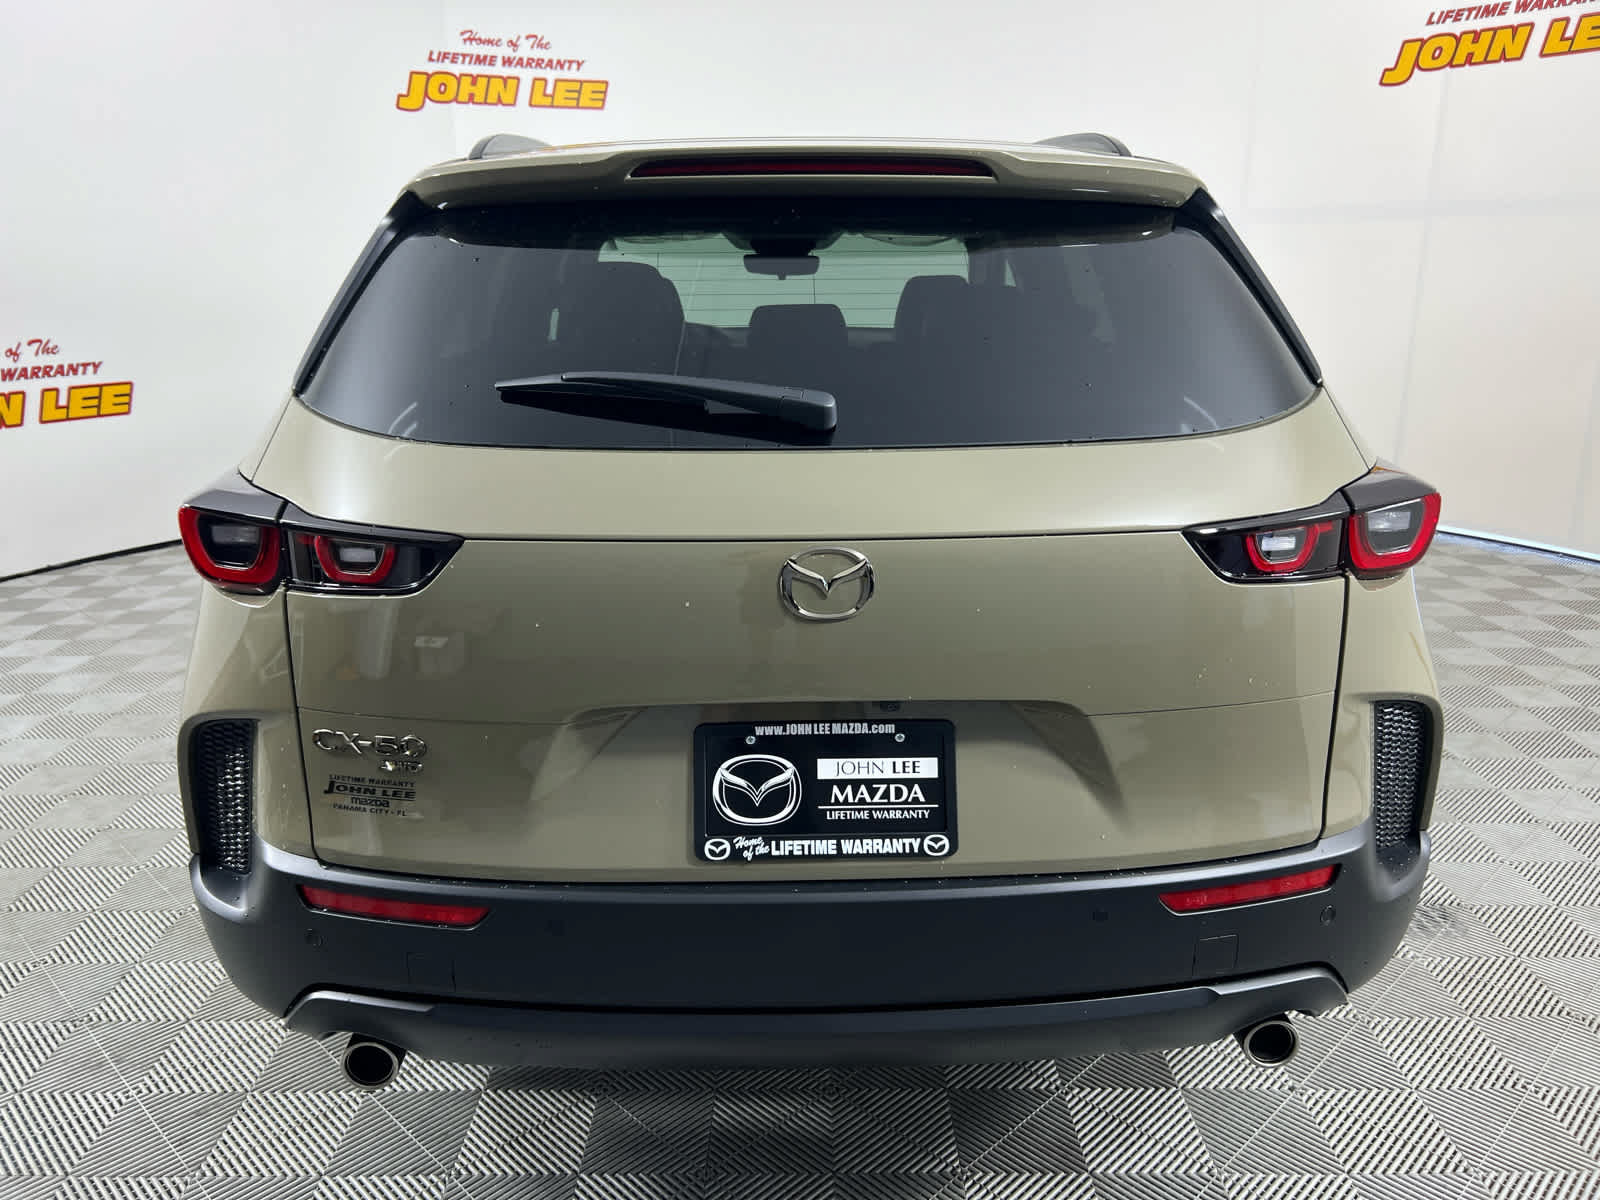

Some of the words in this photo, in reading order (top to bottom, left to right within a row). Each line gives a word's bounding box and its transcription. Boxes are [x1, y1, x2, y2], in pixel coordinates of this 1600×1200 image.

[1425, 2, 1512, 26] LIFETIME
[459, 30, 502, 47] Home
[506, 35, 520, 52] of
[525, 34, 551, 50] The
[427, 50, 498, 67] LIFETIME
[501, 55, 585, 72] WARRANTY
[1379, 22, 1535, 87] JOHN
[396, 70, 520, 112] JOHN
[528, 77, 608, 110] LEE
[4, 341, 21, 363] of
[27, 338, 59, 357] The
[0, 361, 103, 382] WARRANTY
[39, 381, 134, 424] LEE
[813, 723, 831, 735] LEE
[832, 722, 896, 735] MAZDA.com
[312, 728, 427, 758] CX-50
[836, 760, 884, 777] JOHN
[892, 760, 921, 774] LEE
[323, 780, 377, 795] JOHN
[381, 789, 417, 799] LEE
[830, 783, 926, 804] MAZDA
[826, 810, 870, 820] LIFETIME
[872, 809, 930, 819] WARRANTY
[733, 836, 763, 850] Home
[742, 846, 754, 861] of
[755, 841, 770, 856] the
[771, 839, 838, 856] LIFETIME
[840, 837, 921, 855] WARRANTY
